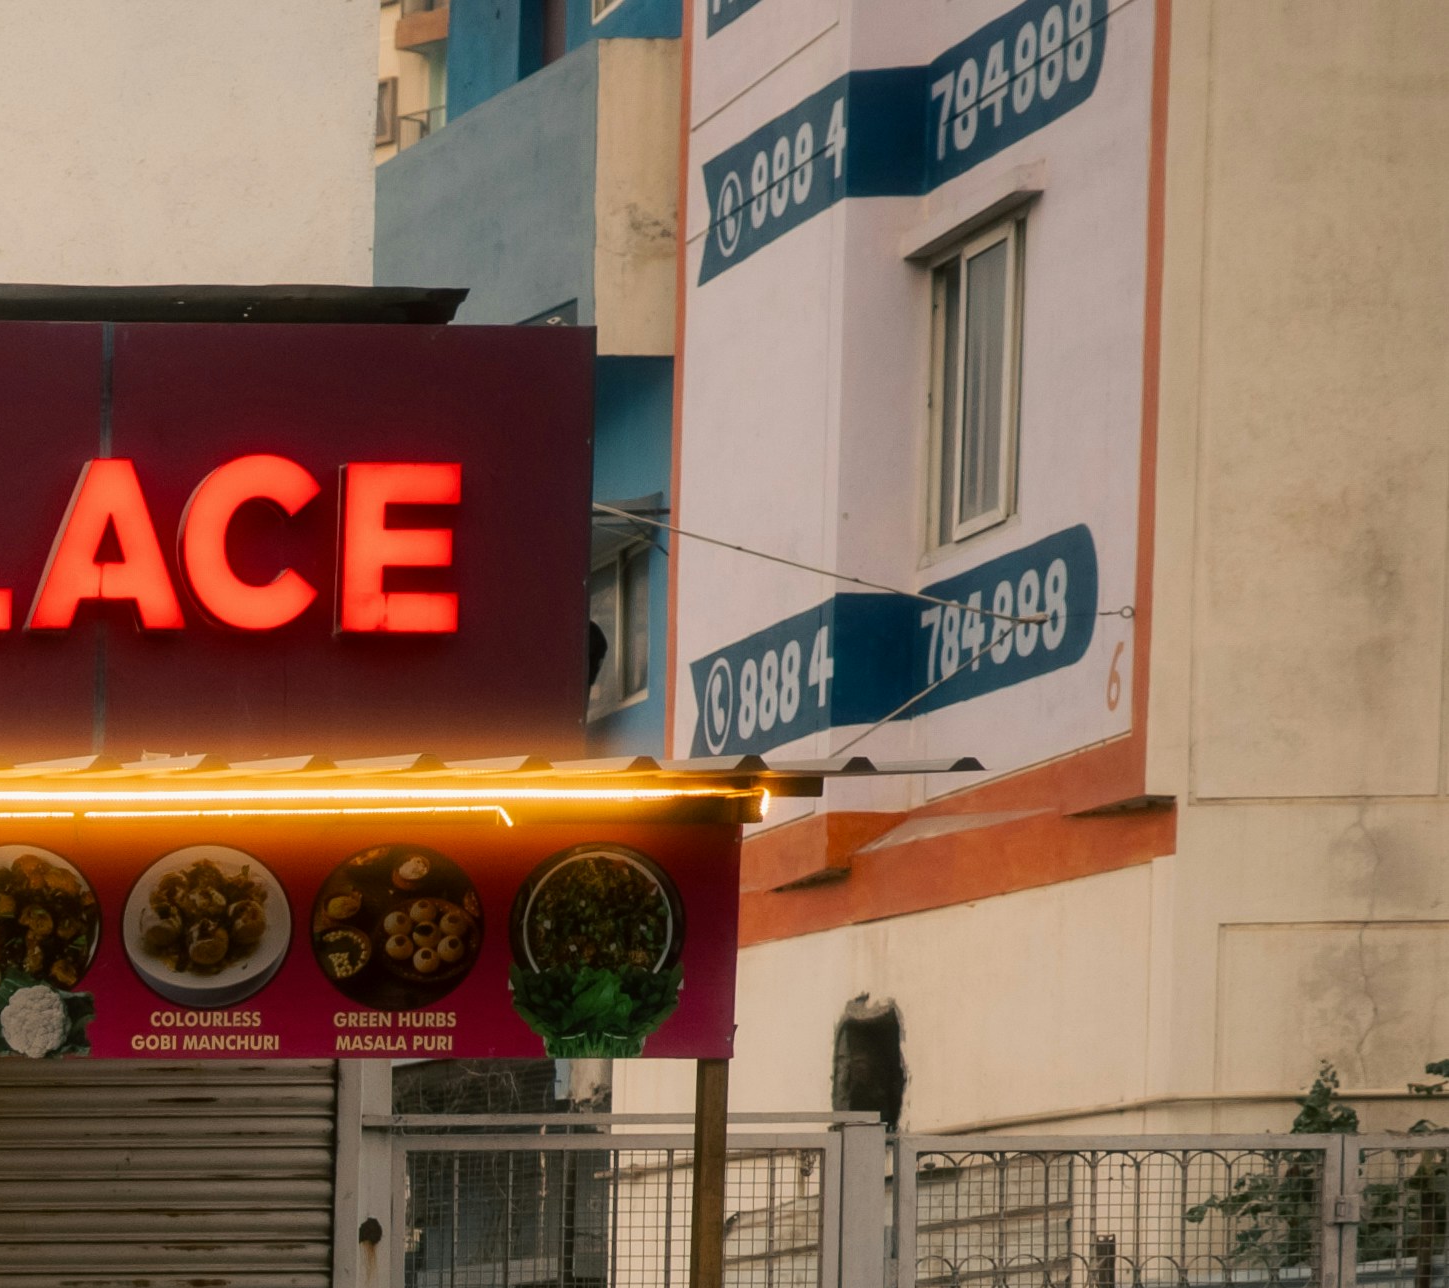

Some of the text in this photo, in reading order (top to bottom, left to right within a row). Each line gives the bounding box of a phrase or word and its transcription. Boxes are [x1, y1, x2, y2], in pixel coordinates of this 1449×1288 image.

[150, 1011, 261, 1027] COLOURLESS
[333, 1012, 457, 1028] GREEN HURBS
[131, 1034, 280, 1051] GOBI MANCHURI
[335, 1034, 453, 1051] MASALA PURI
